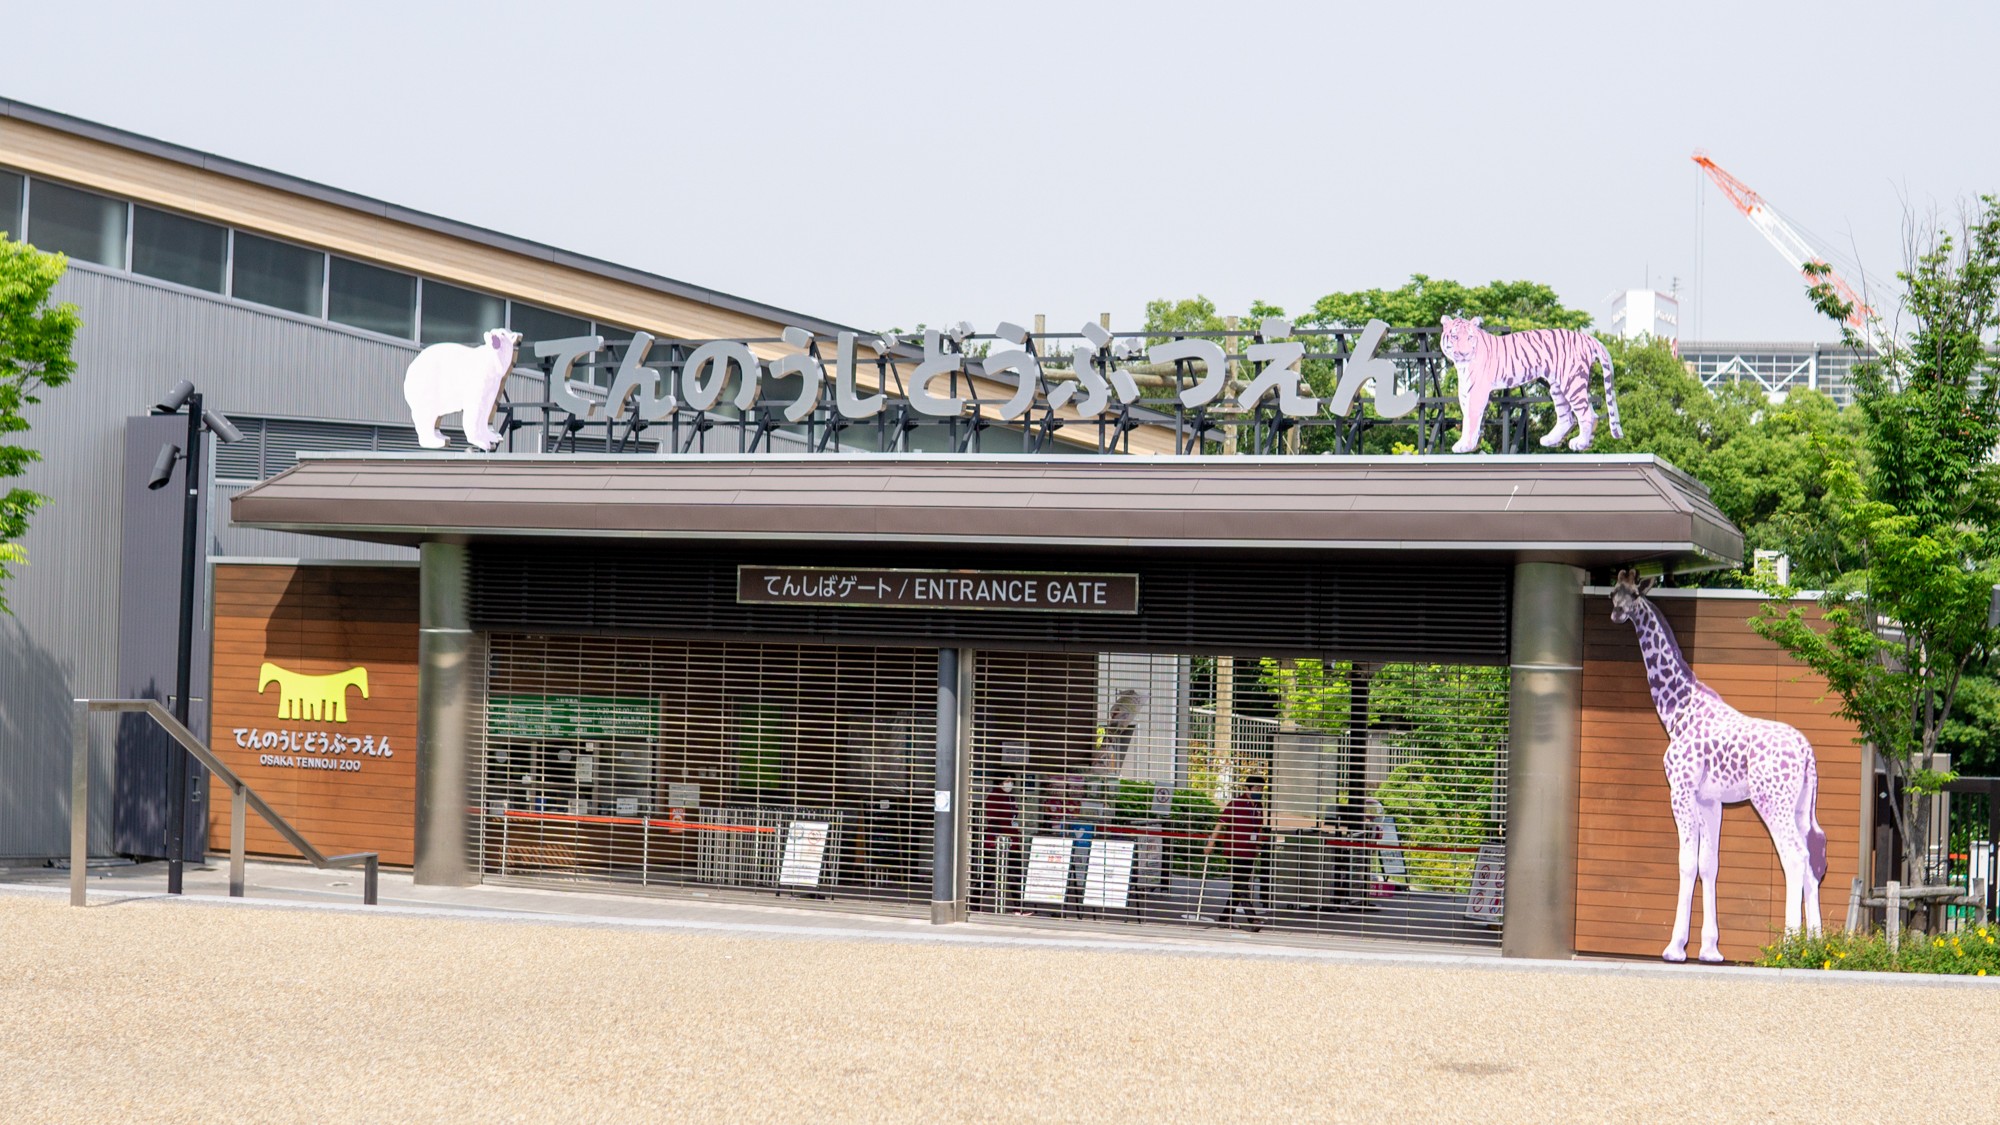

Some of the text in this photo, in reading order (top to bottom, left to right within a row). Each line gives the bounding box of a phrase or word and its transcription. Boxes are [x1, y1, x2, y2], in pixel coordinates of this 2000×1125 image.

[534, 318, 1419, 422] てんのうじどうぶつえん
[764, 574, 892, 599] てんしばゲート
[915, 578, 1038, 602] ENTRANCE
[1047, 581, 1107, 604] GATE
[232, 728, 393, 757] てんのうじどうぶつえん
[260, 754, 361, 772] OSAKA TENNOJI ZOO
